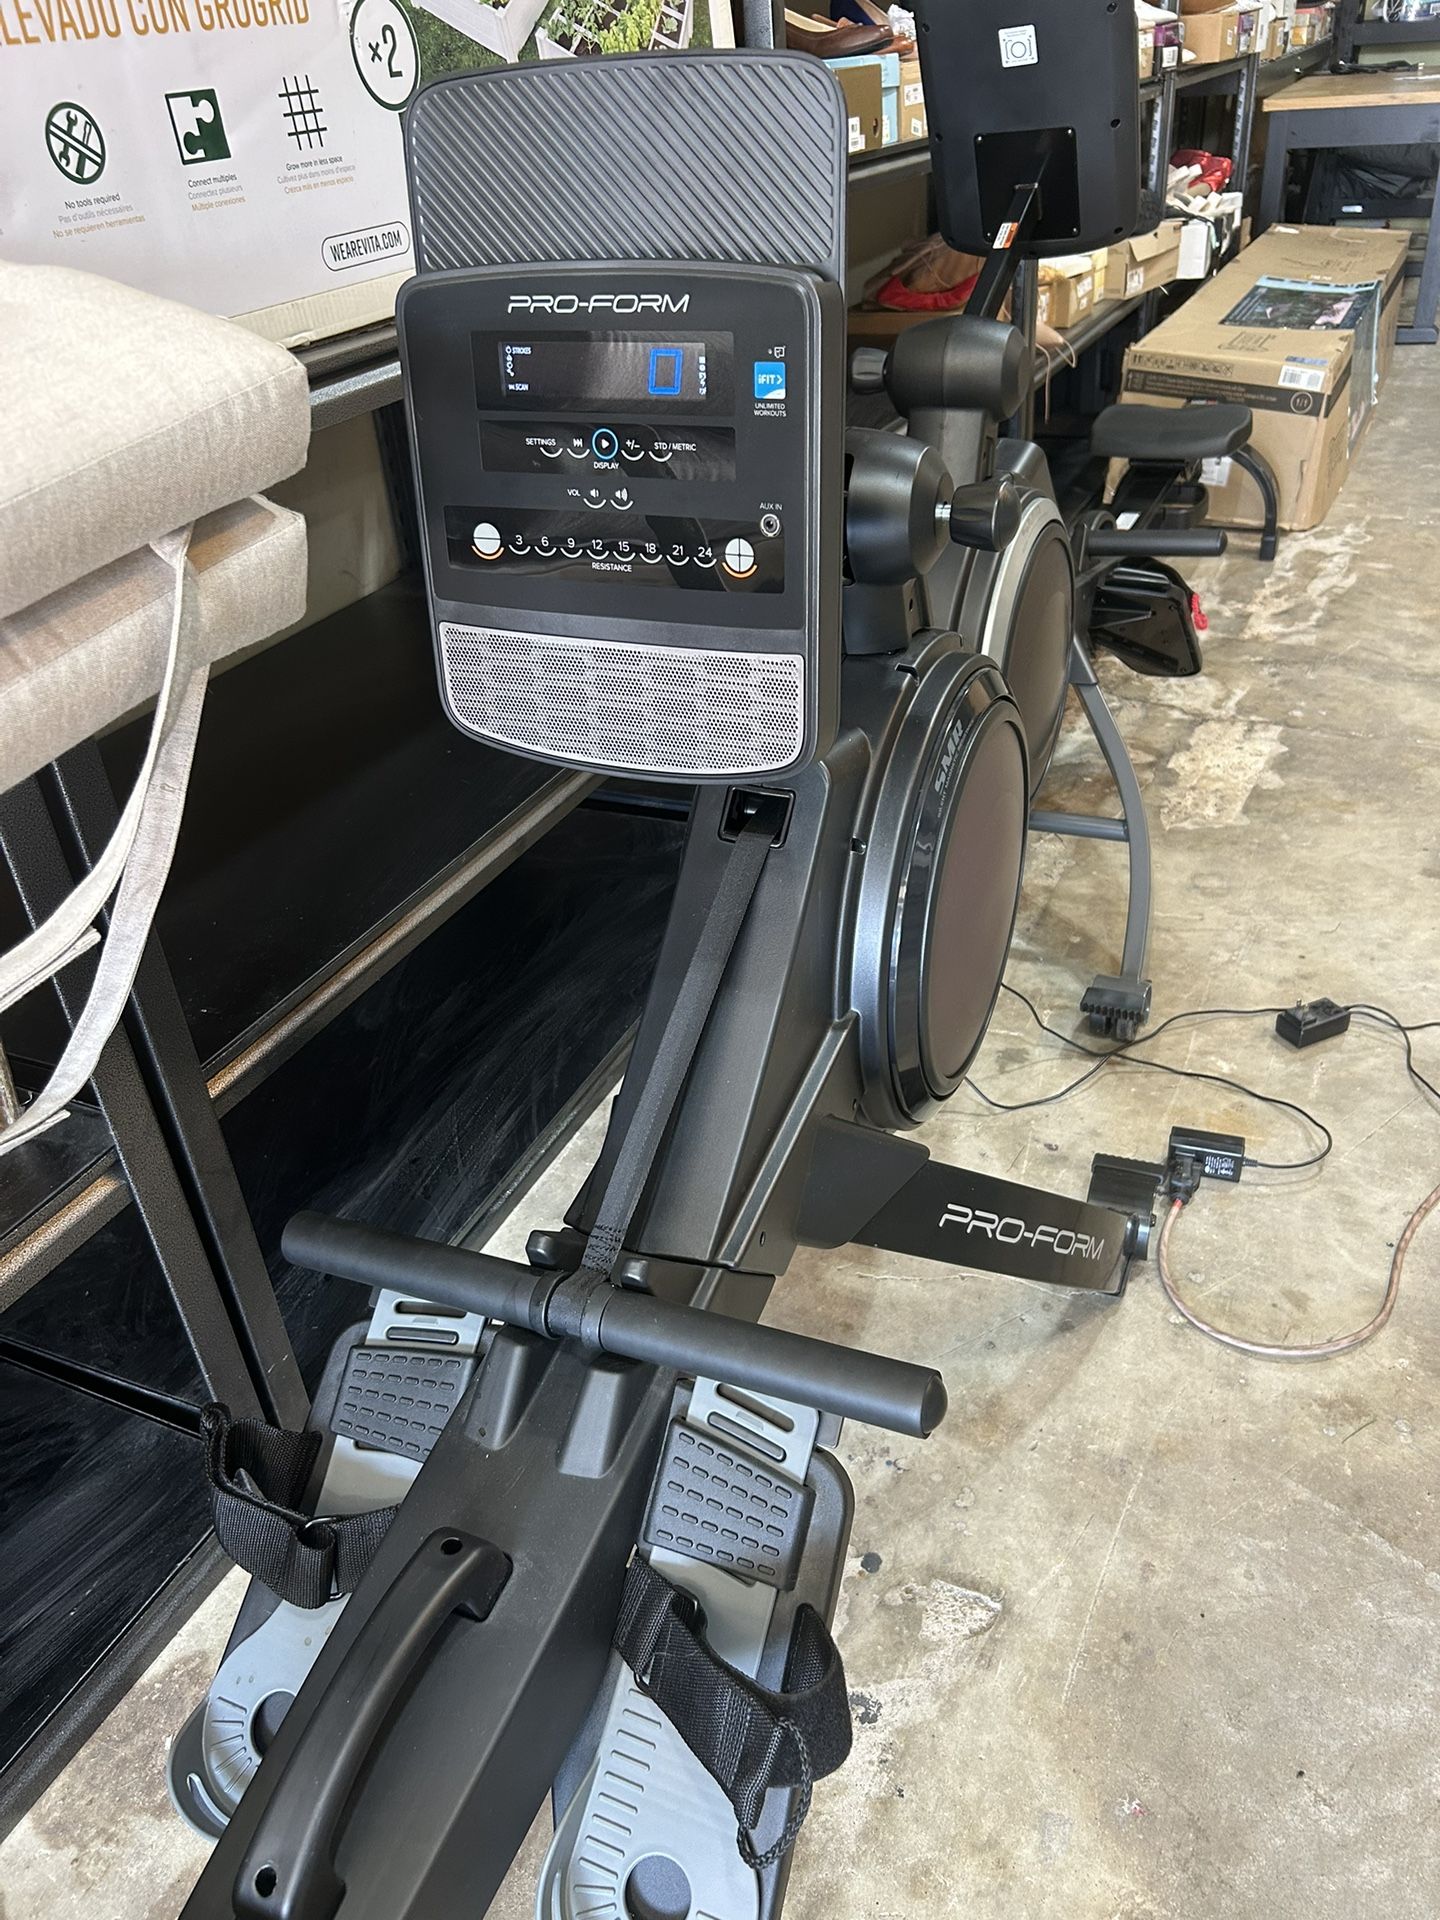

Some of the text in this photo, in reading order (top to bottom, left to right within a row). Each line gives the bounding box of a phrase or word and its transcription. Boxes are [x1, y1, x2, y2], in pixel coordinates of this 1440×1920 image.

[0, 0, 310, 45] LEVADO CON GROGRID
[286, 163, 300, 171] Grow
[329, 156, 343, 164] space
[188, 174, 237, 188] Connect multiples
[64, 192, 121, 210] No tools required
[58, 215, 71, 223] Pas
[52, 230, 64, 238] No
[74, 223, 105, 234] requieren
[105, 215, 145, 228] herramientas
[330, 230, 402, 262] WEAREVITA.COM
[507, 294, 690, 314] PRO-FORM
[648, 348, 683, 395] 0
[758, 374, 776, 385] iFIT
[515, 383, 529, 391] SCAN
[754, 402, 785, 410] UNLIMITED
[754, 409, 786, 417] WORKOUTS
[525, 437, 556, 447] SETTINGS
[654, 442, 668, 450] STD
[672, 443, 697, 451] METRIC
[593, 461, 619, 470] DISPLAY
[567, 489, 581, 497] VOL
[759, 502, 783, 511] AUX IN
[515, 535, 713, 558] 3 6 9 12 15 18 21 24
[591, 562, 632, 573] RESISTANCE
[934, 718, 964, 795] SMR
[938, 1203, 1105, 1261] PRO-FORM
